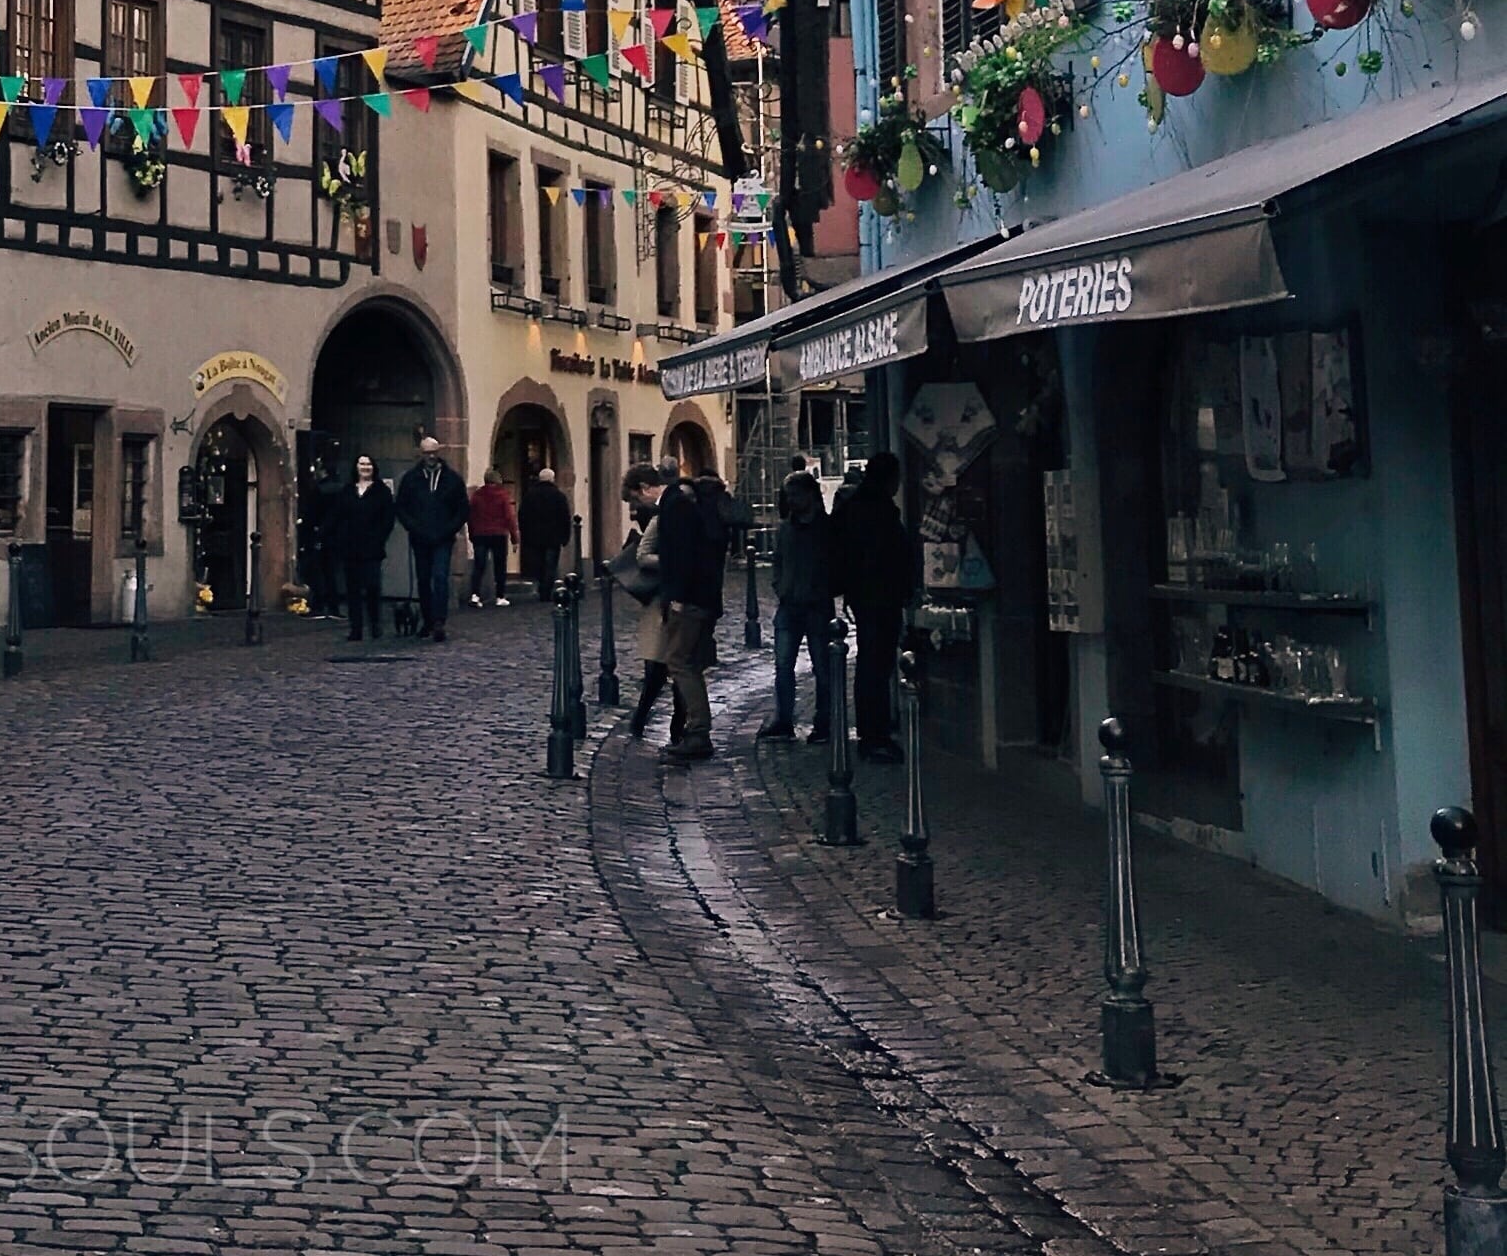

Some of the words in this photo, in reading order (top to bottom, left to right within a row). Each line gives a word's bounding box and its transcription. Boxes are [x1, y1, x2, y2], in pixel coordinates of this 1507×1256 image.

[1016, 256, 1132, 324] POTERIES
[799, 329, 852, 380] AMBIANCE
[852, 311, 898, 366] ALSACE
